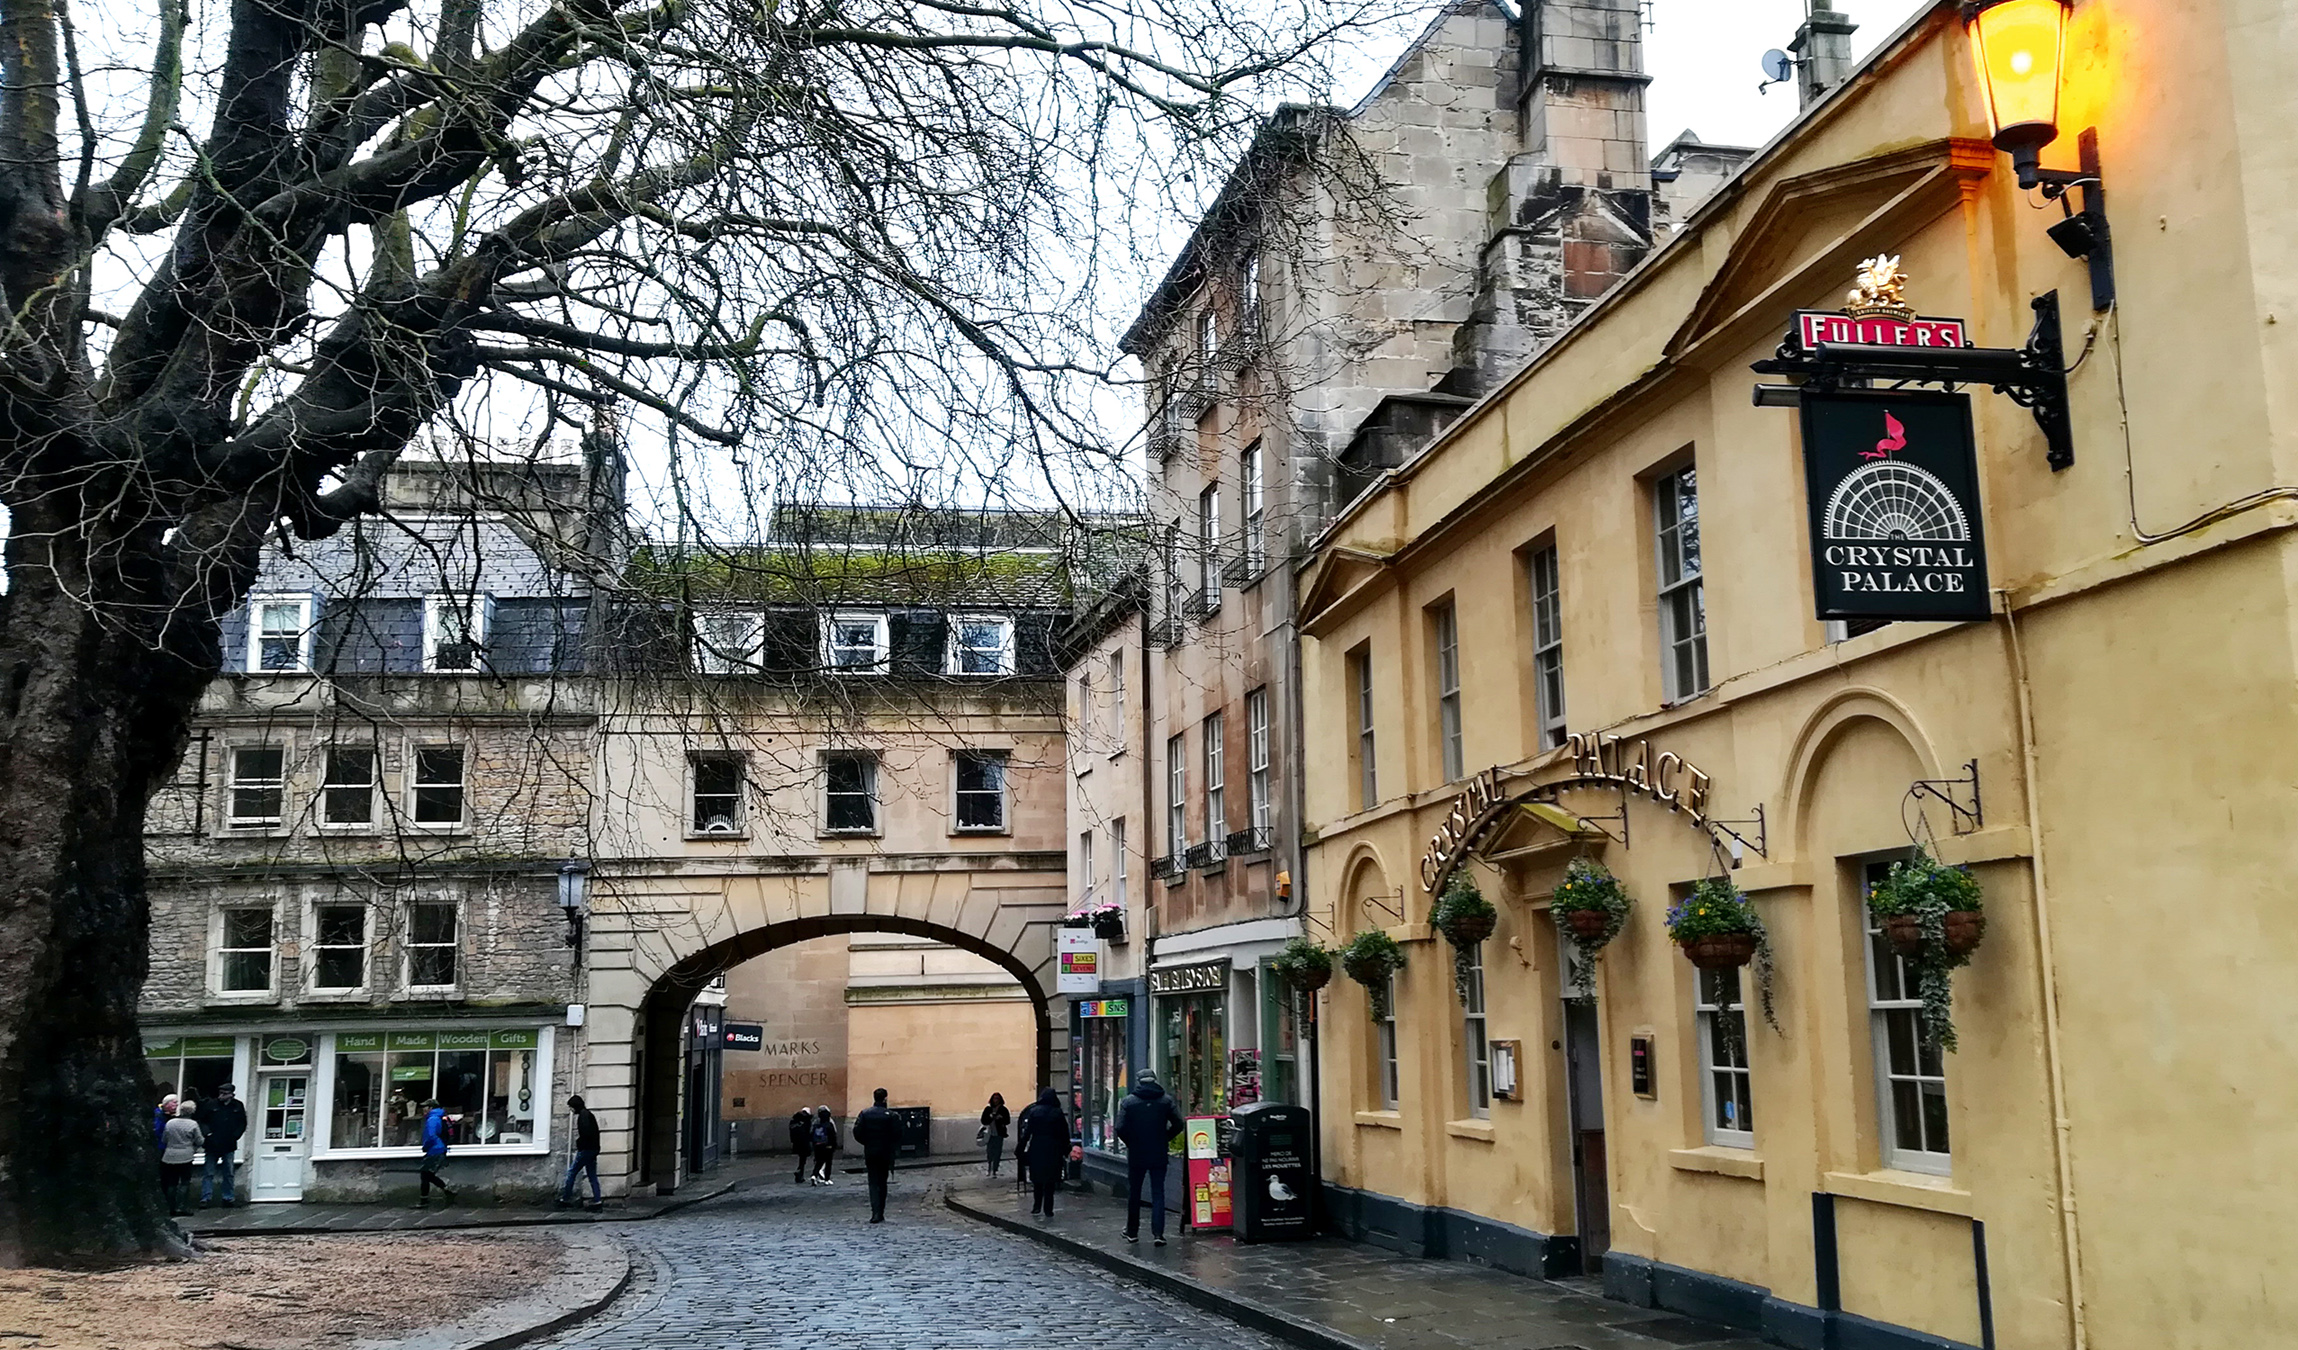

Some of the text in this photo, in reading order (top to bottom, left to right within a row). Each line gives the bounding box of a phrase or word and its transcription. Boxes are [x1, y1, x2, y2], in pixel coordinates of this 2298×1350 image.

[1810, 316, 1957, 348] FULLER'S
[1825, 545, 1974, 568] CRYSTAL
[1841, 571, 1965, 593] PALACE
[1421, 731, 1710, 893] CRYSTAL PALACE
[344, 1033, 527, 1047] Hand Made Wooden Gifts
[735, 1033, 759, 1043] Blacks
[764, 1041, 820, 1056] MARKS
[791, 1059, 798, 1069] &
[760, 1072, 828, 1088] SPENCER
